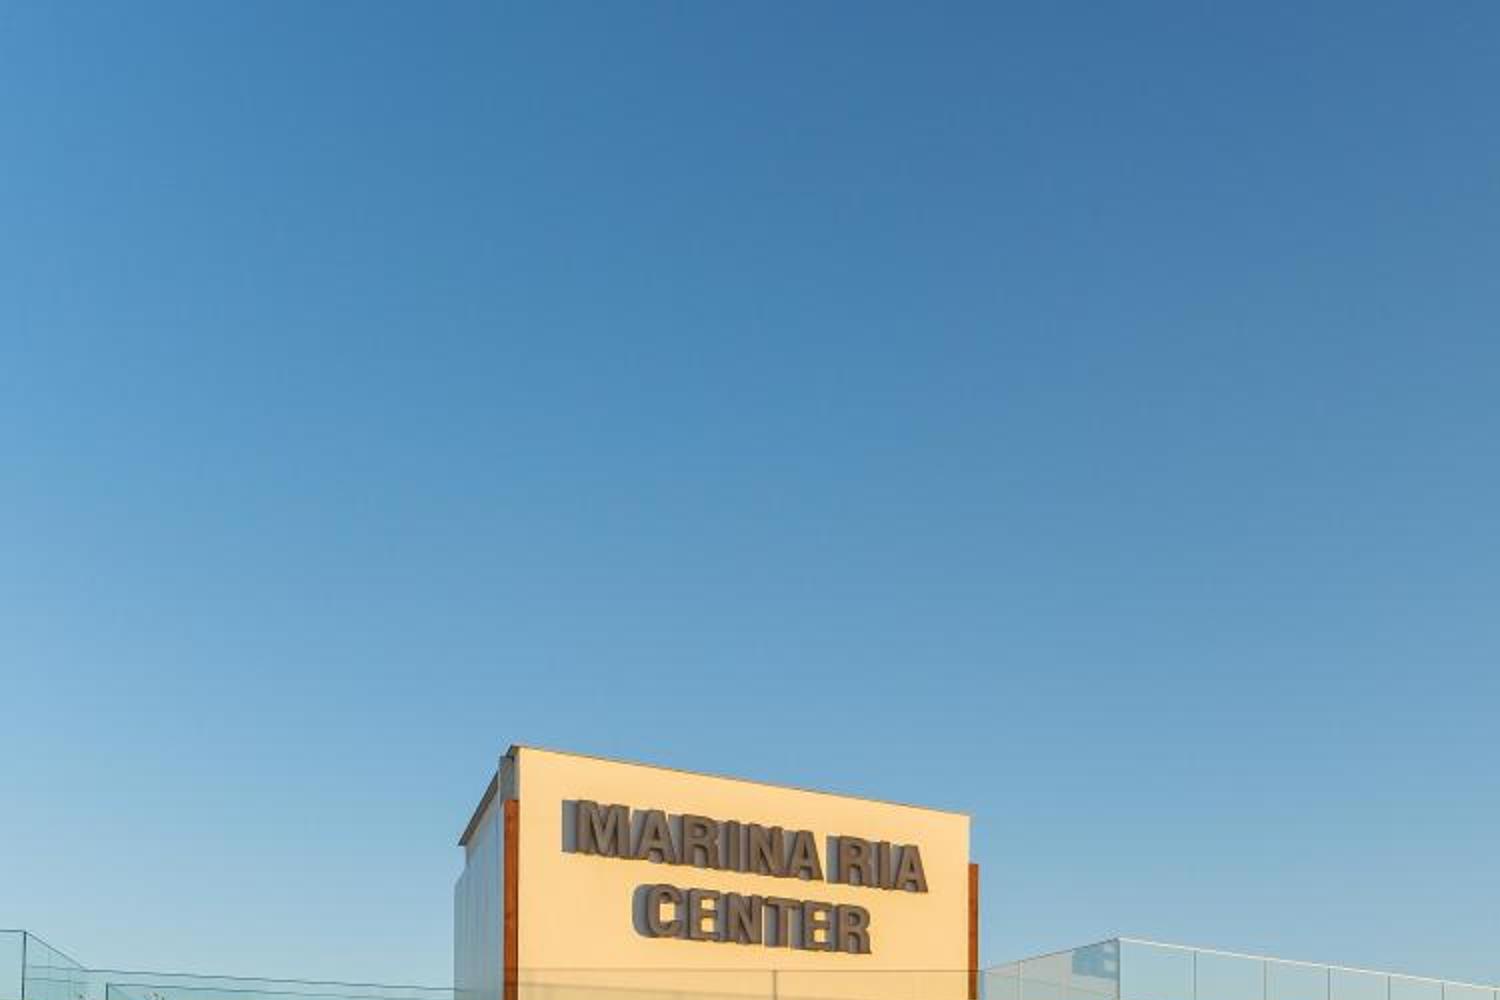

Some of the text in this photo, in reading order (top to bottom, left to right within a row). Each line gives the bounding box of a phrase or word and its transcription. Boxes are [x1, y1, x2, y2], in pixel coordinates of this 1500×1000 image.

[563, 800, 928, 893] MARINA RIA
[632, 884, 872, 955] CENTER
